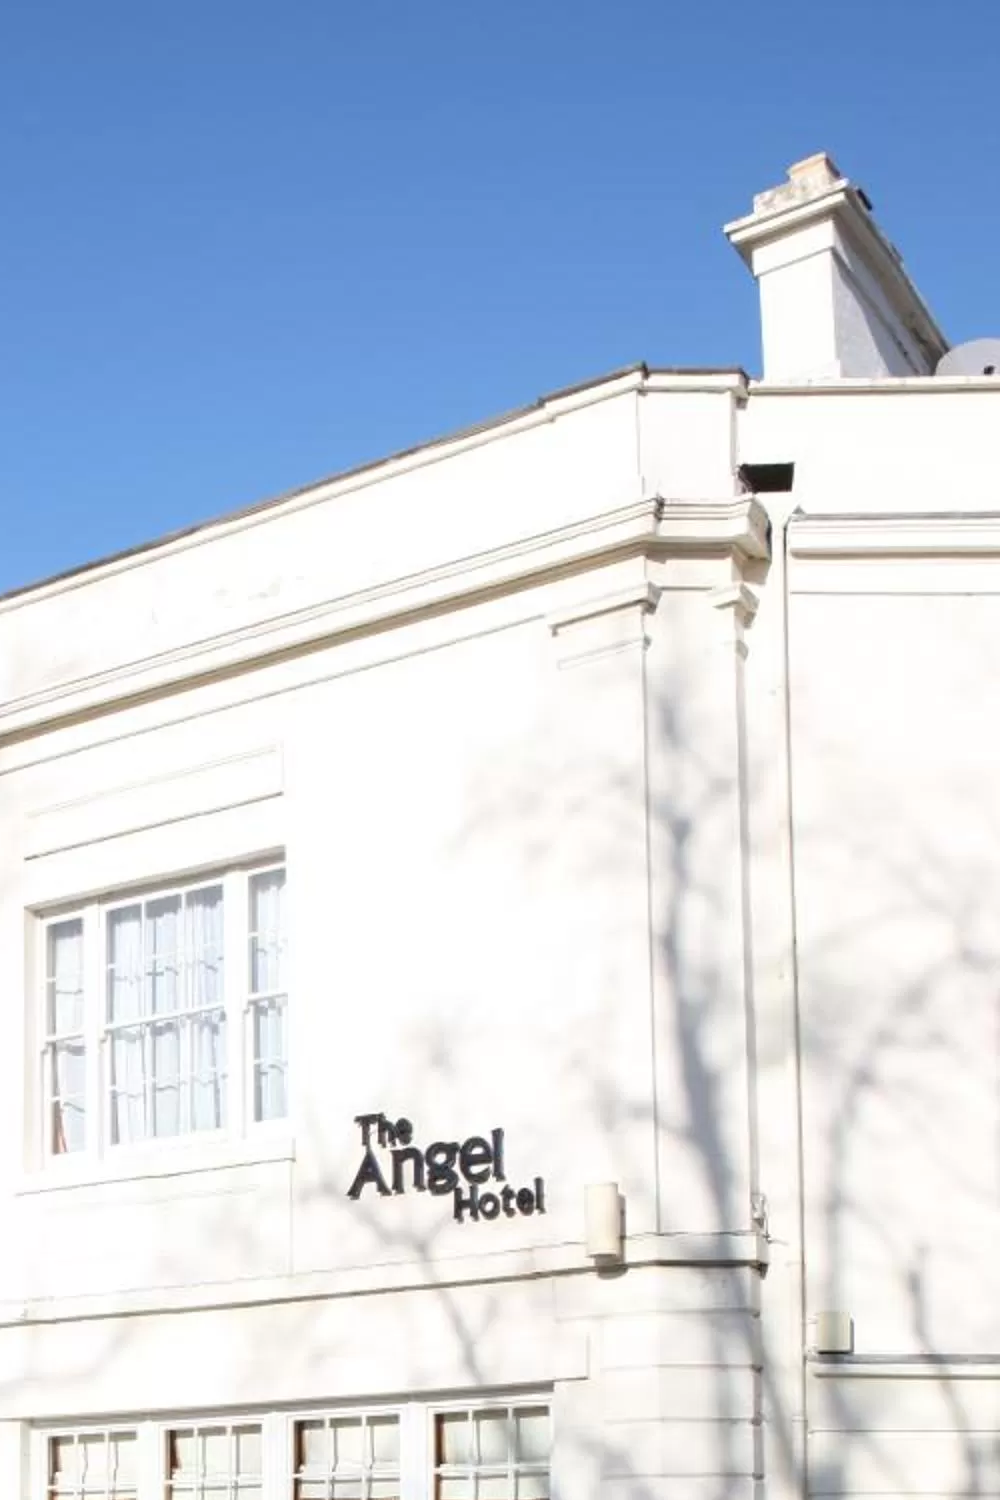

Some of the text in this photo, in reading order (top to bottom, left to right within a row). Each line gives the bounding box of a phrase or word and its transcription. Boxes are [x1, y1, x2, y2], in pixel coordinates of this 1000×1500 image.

[354, 1112, 413, 1148] The
[346, 1127, 506, 1200] Angel
[453, 1176, 546, 1223] Hotel
